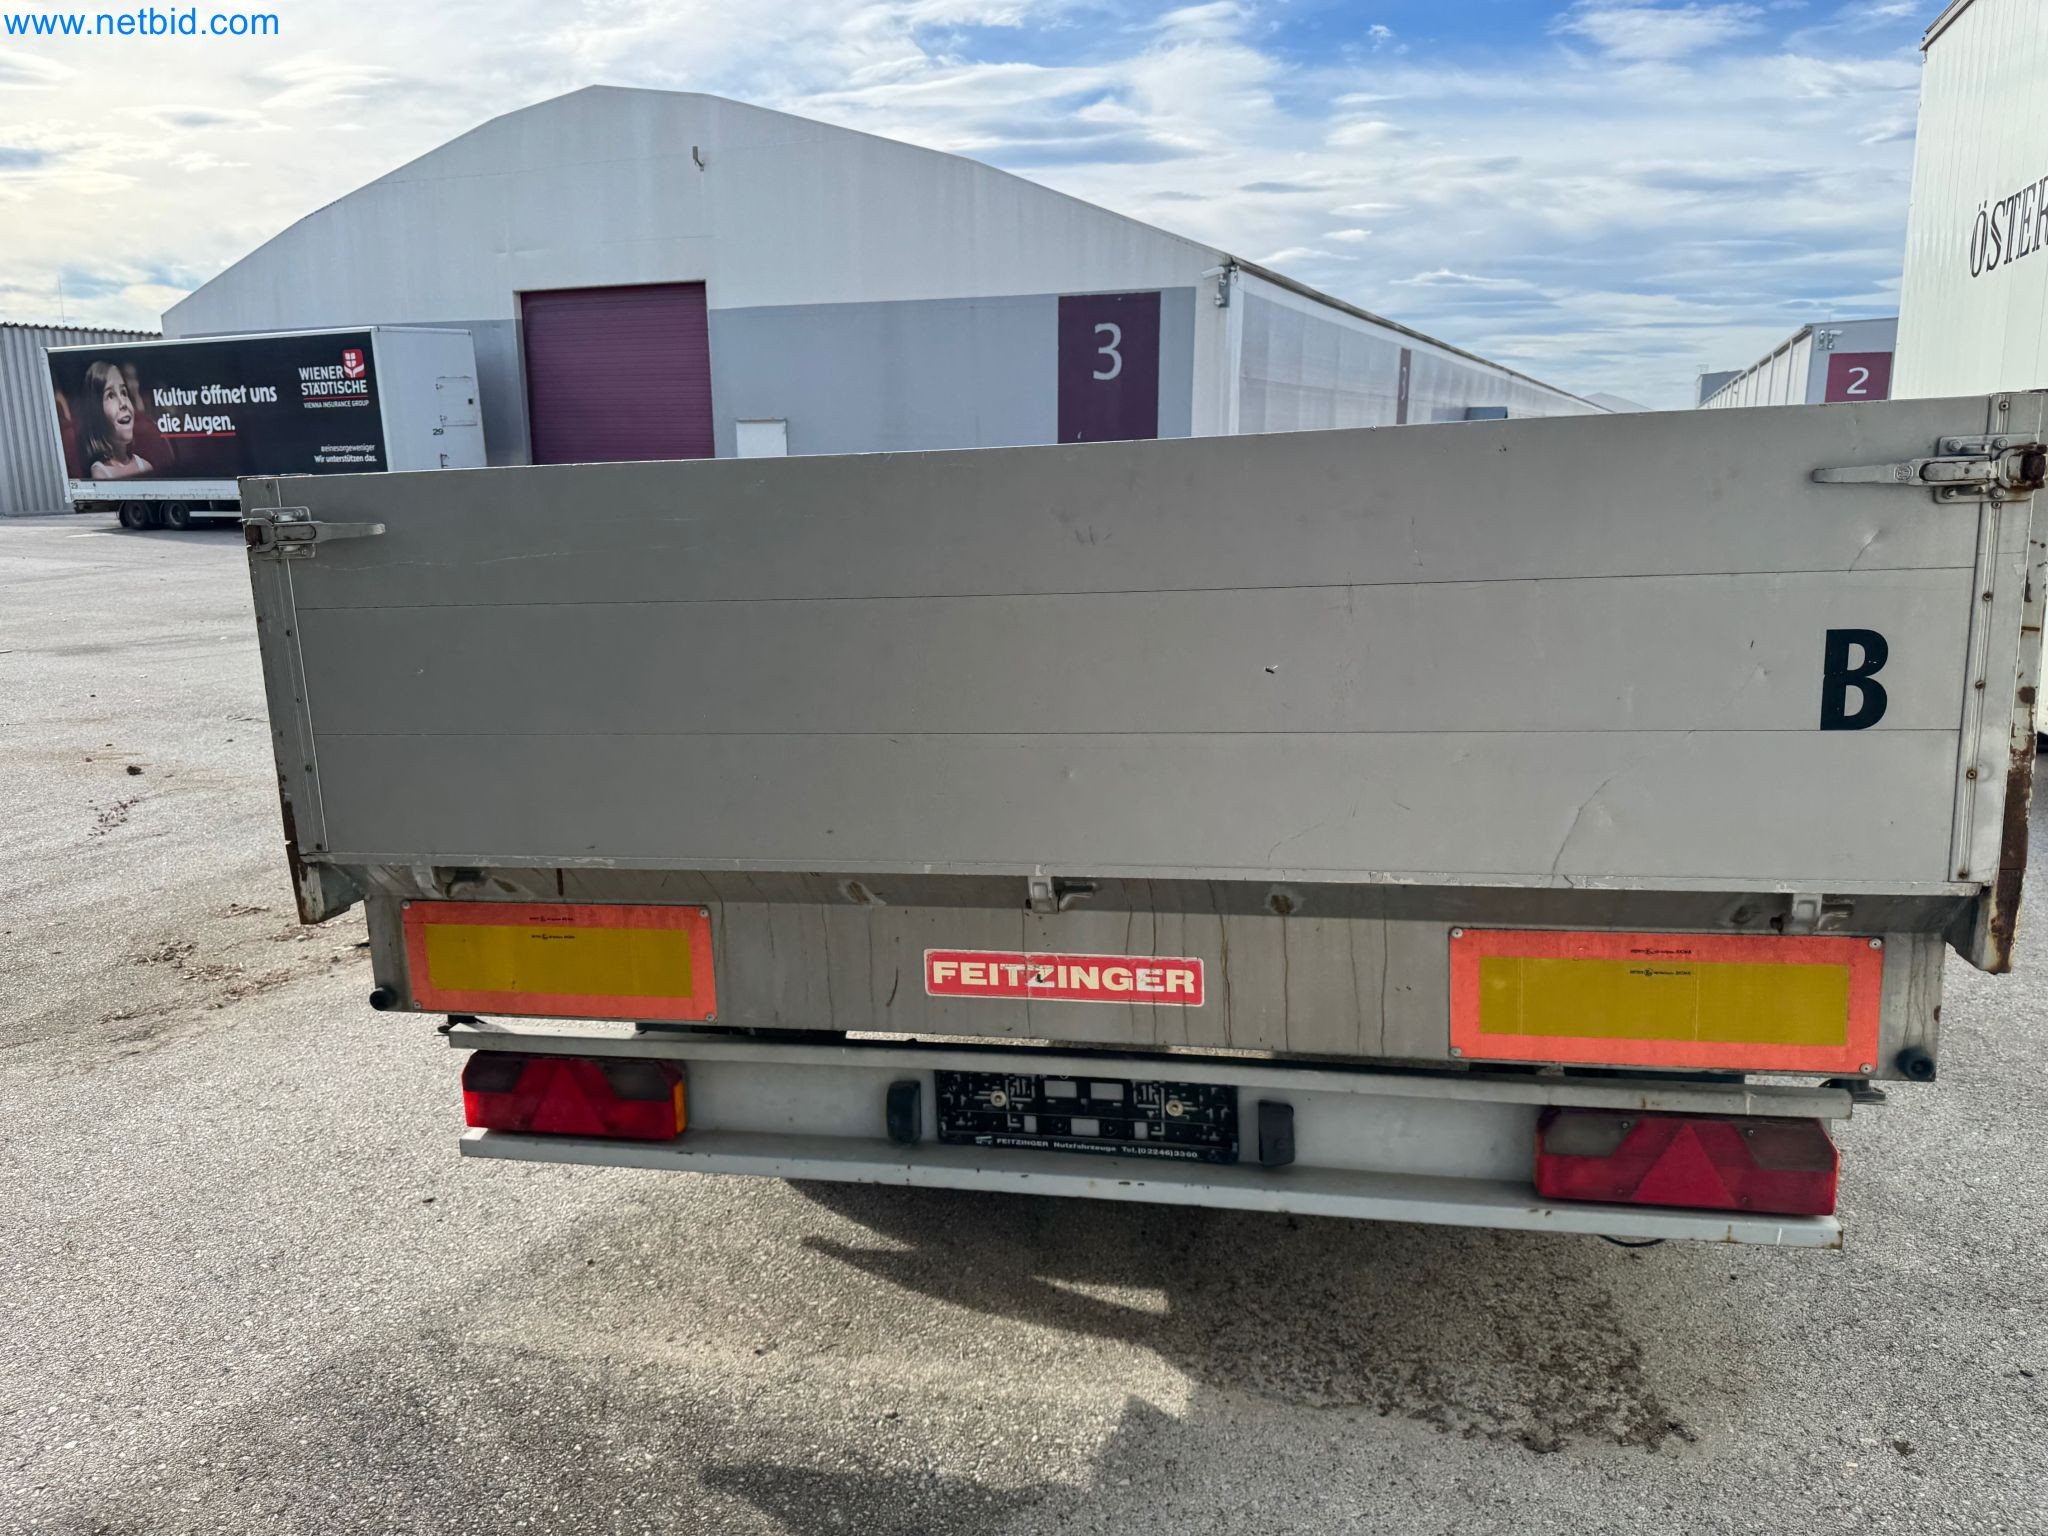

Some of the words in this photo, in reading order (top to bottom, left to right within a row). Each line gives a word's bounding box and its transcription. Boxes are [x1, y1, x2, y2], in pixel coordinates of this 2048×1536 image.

[1093, 322, 1123, 380] 3
[298, 365, 344, 380] WIENER
[1846, 366, 1869, 394] 2
[152, 386, 198, 407] Kultur
[200, 384, 247, 405] öffnet
[249, 385, 278, 403] uns
[301, 380, 368, 396] STÄDTISCHE
[157, 413, 181, 433] die
[183, 412, 236, 435] Augen.
[314, 455, 325, 463] Wir
[326, 454, 364, 462] unterstützen
[1820, 629, 1889, 731] B
[933, 960, 1195, 994] FEITZINGER
[996, 1137, 1049, 1148] FEITZINGER
